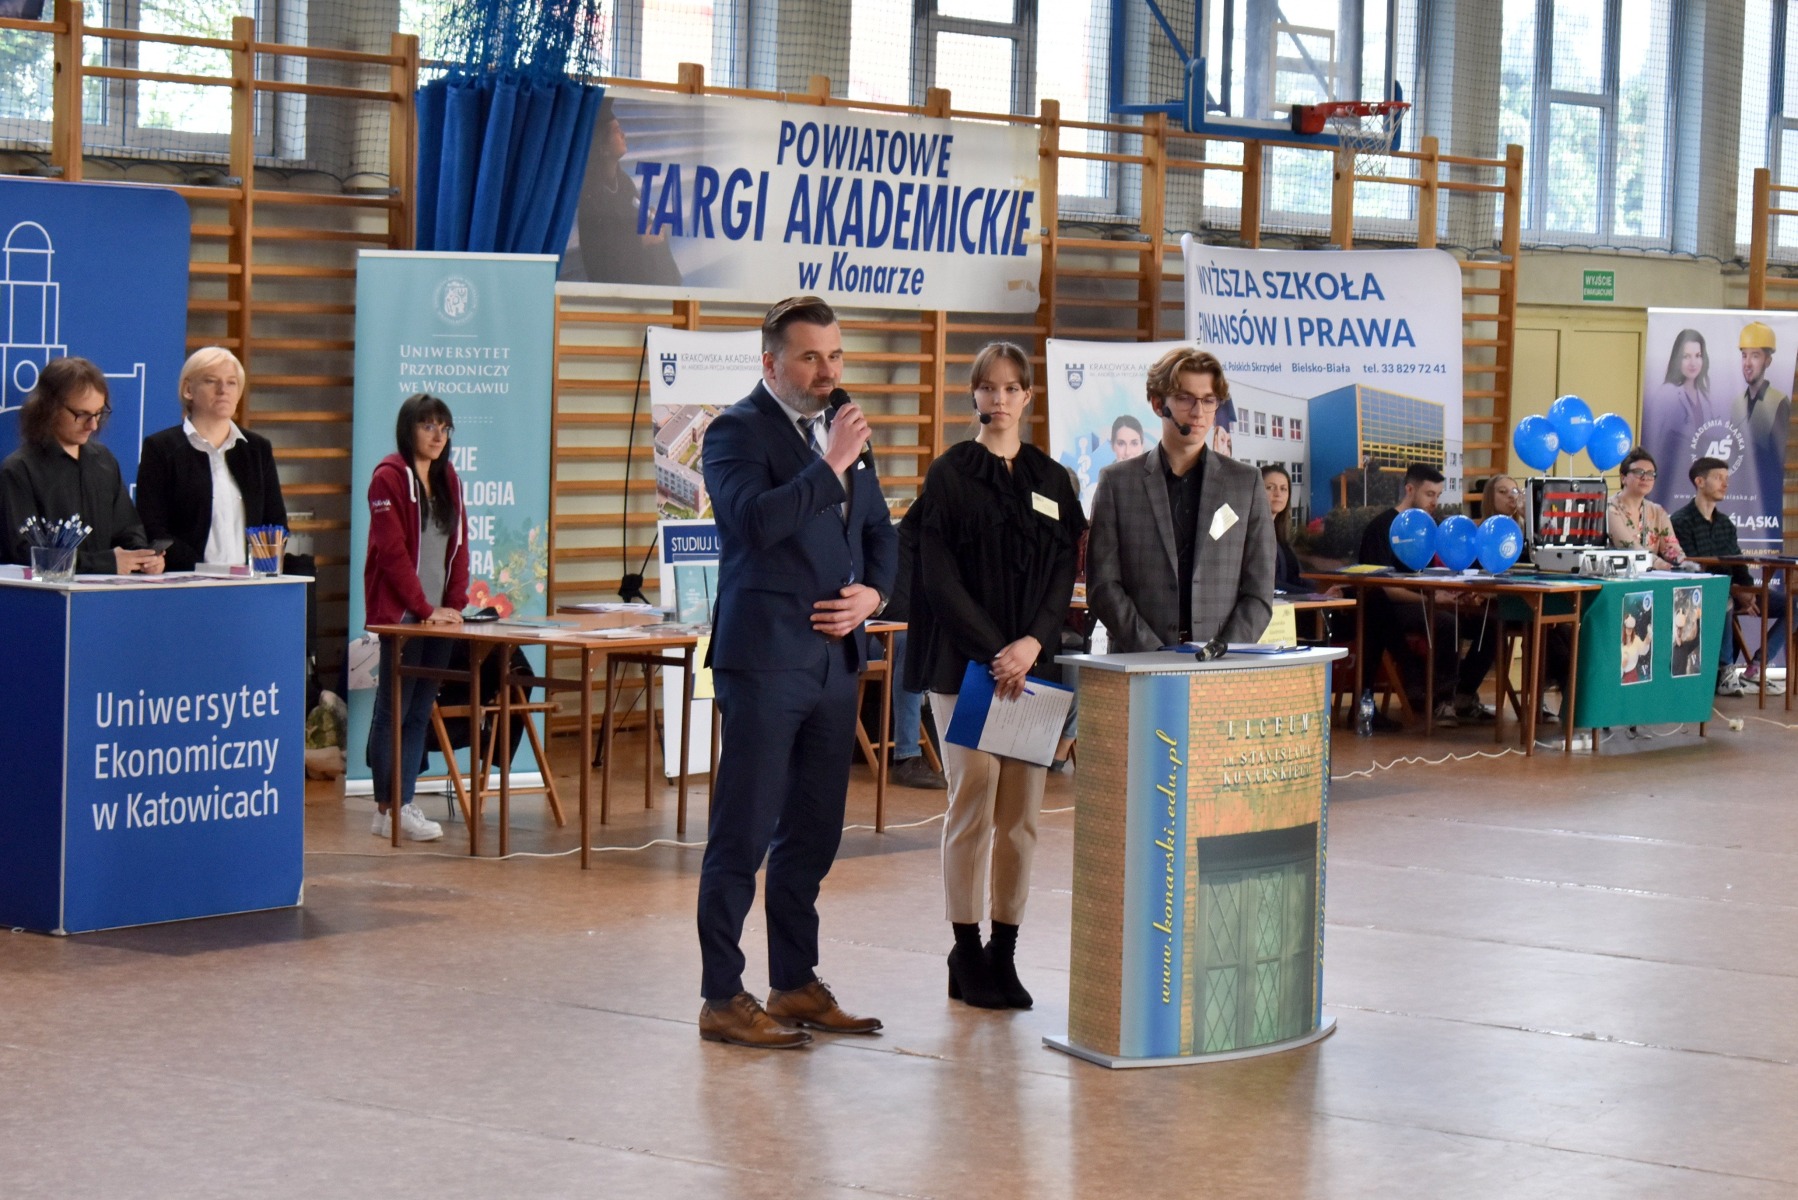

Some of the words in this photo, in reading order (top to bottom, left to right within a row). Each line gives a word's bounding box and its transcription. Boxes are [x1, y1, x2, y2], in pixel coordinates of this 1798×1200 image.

[777, 120, 954, 178] POWIATOWE
[635, 161, 770, 242] TARGI
[783, 174, 1035, 257] AKADEMICKIE
[798, 261, 822, 291] w
[829, 251, 925, 296] Konarze
[1196, 260, 1262, 299] WYŻSZA
[1262, 270, 1386, 301] SZKOŁA
[1199, 309, 1277, 347] FINANSÓW
[1284, 316, 1293, 346] I
[1298, 317, 1417, 348] PRAWA
[681, 353, 722, 363] KRAKOWSKA
[725, 354, 761, 363] AKADEMIA
[1228, 362, 1251, 372] Polskich
[1252, 362, 1281, 373] Skrzydeł
[1292, 363, 1351, 373] Bielsko-Biała
[1363, 363, 1379, 373] tel.
[1381, 364, 1394, 373] 33
[1396, 364, 1416, 373] 829
[1419, 364, 1431, 373] 72
[1433, 364, 1447, 373] 41
[1691, 420, 1722, 450] AKADEMIA
[452, 447, 478, 472] ZIE
[463, 481, 515, 506] LOGIA
[468, 516, 496, 545] SIĘ
[1729, 512, 1780, 531] ŚLĄSKA
[671, 536, 712, 552] STUDIUJ
[96, 682, 280, 729] Uniwersytet
[1228, 712, 1309, 740] LICEUM
[95, 735, 280, 780] Ekonomiczny
[92, 802, 119, 831] w
[126, 780, 280, 829] Katowicach
[1152, 728, 1183, 1005] www.konarski.edu.pl
